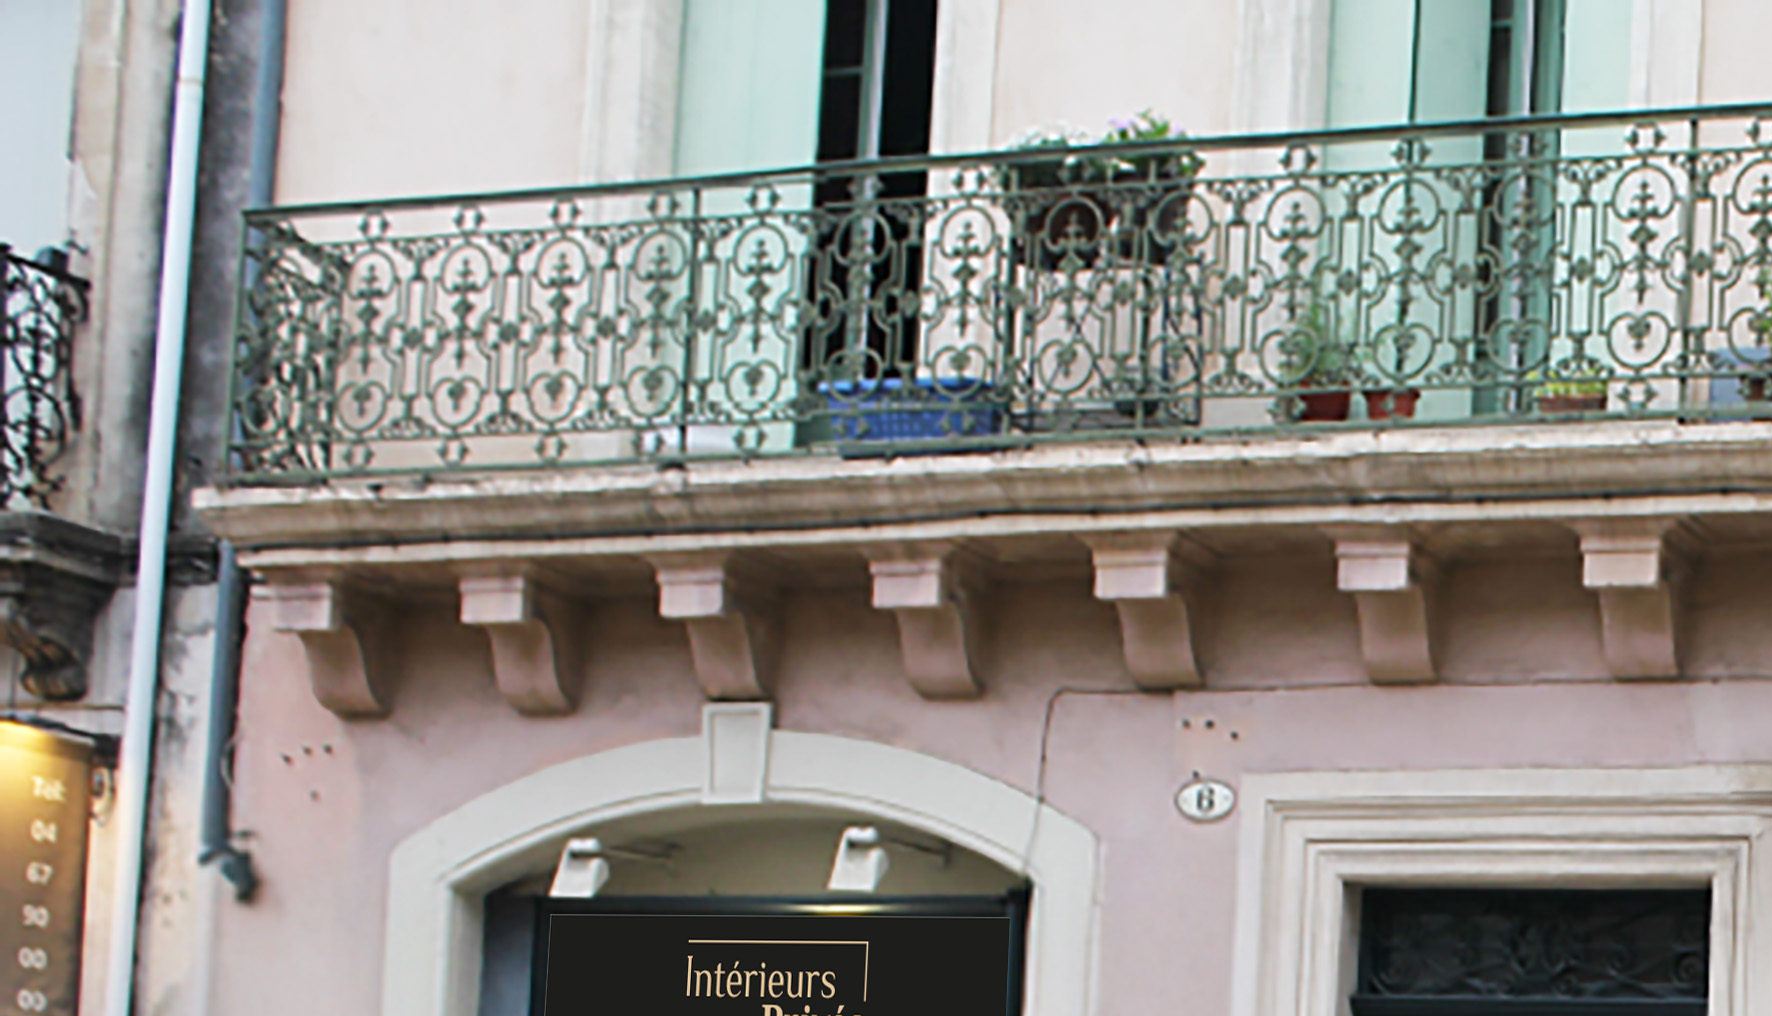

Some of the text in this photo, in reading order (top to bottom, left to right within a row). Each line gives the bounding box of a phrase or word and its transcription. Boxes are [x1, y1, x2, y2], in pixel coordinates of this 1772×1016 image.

[1196, 785, 1215, 813] 6
[31, 819, 57, 843] 04
[686, 955, 836, 999] Intérieurs
